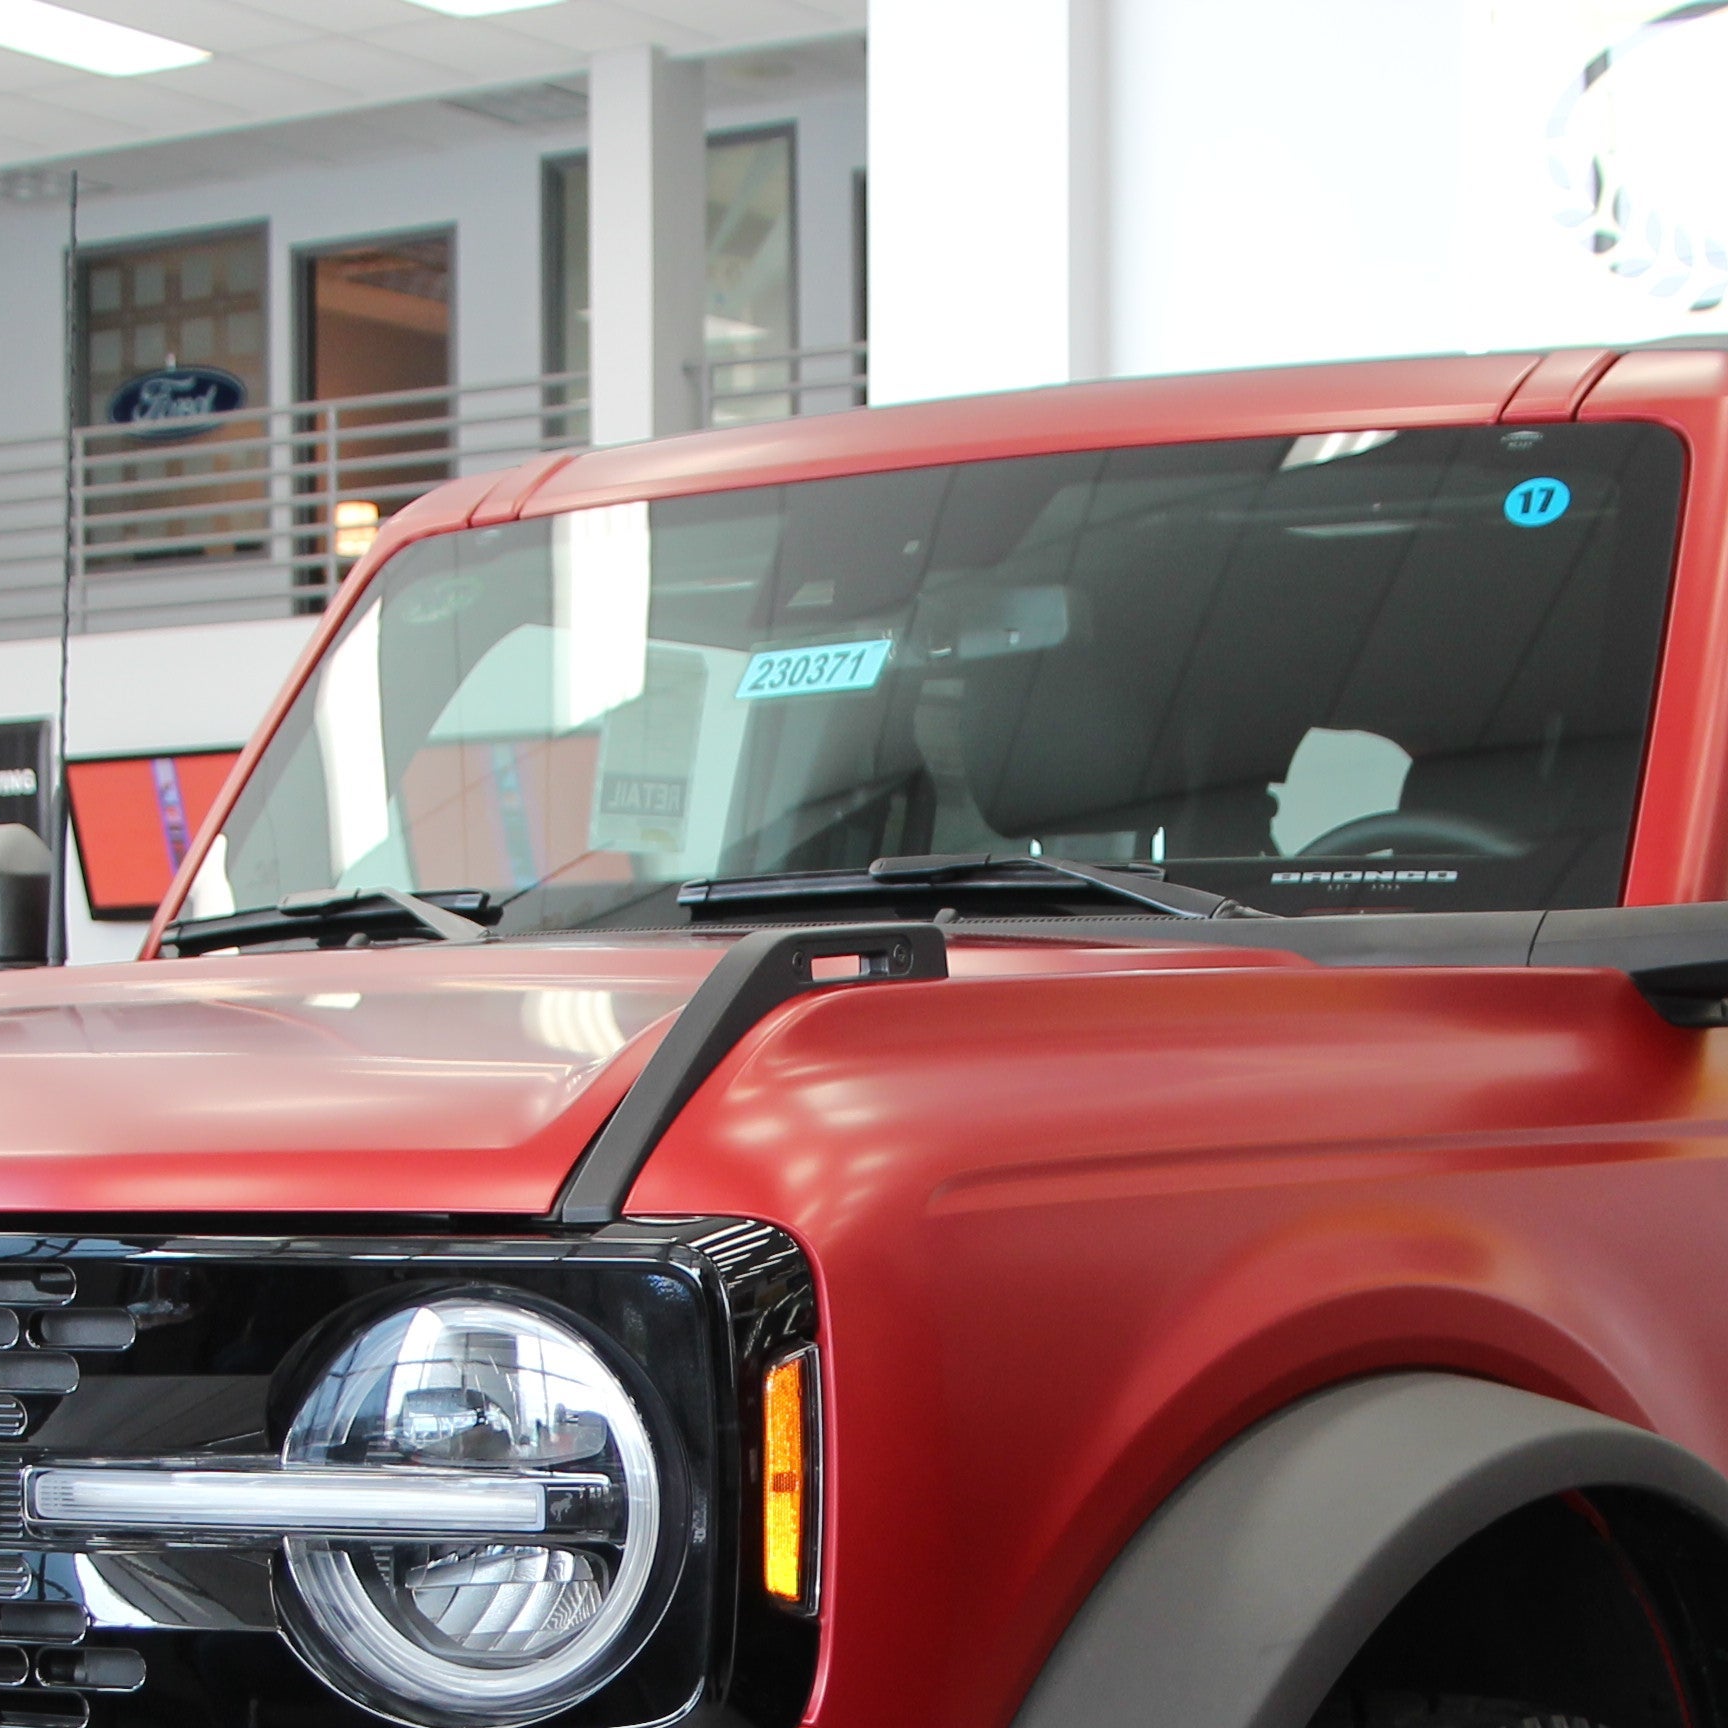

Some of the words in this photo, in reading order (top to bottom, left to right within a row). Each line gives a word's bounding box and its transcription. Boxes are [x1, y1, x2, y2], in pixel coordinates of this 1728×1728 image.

[1518, 486, 1557, 515] 17
[747, 648, 867, 691] 230371
[1271, 870, 1458, 884] BRONCO
